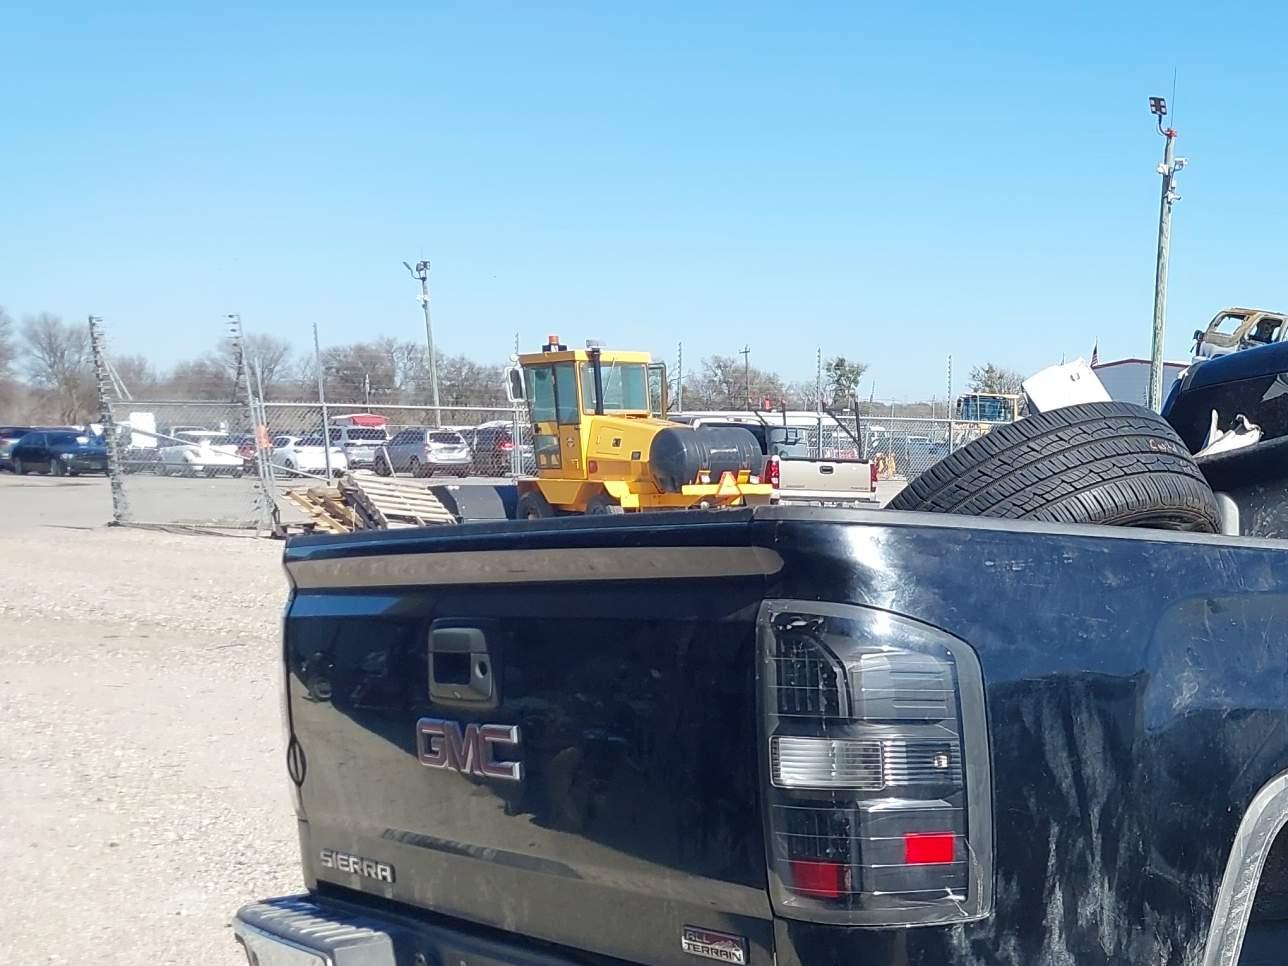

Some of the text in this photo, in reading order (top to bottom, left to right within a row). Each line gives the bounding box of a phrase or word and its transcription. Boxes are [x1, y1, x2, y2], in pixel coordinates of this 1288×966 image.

[416, 717, 522, 780] GMC
[319, 848, 393, 883] SIERRA
[685, 929, 711, 945] ALL
[684, 941, 743, 963] TERRAIN
